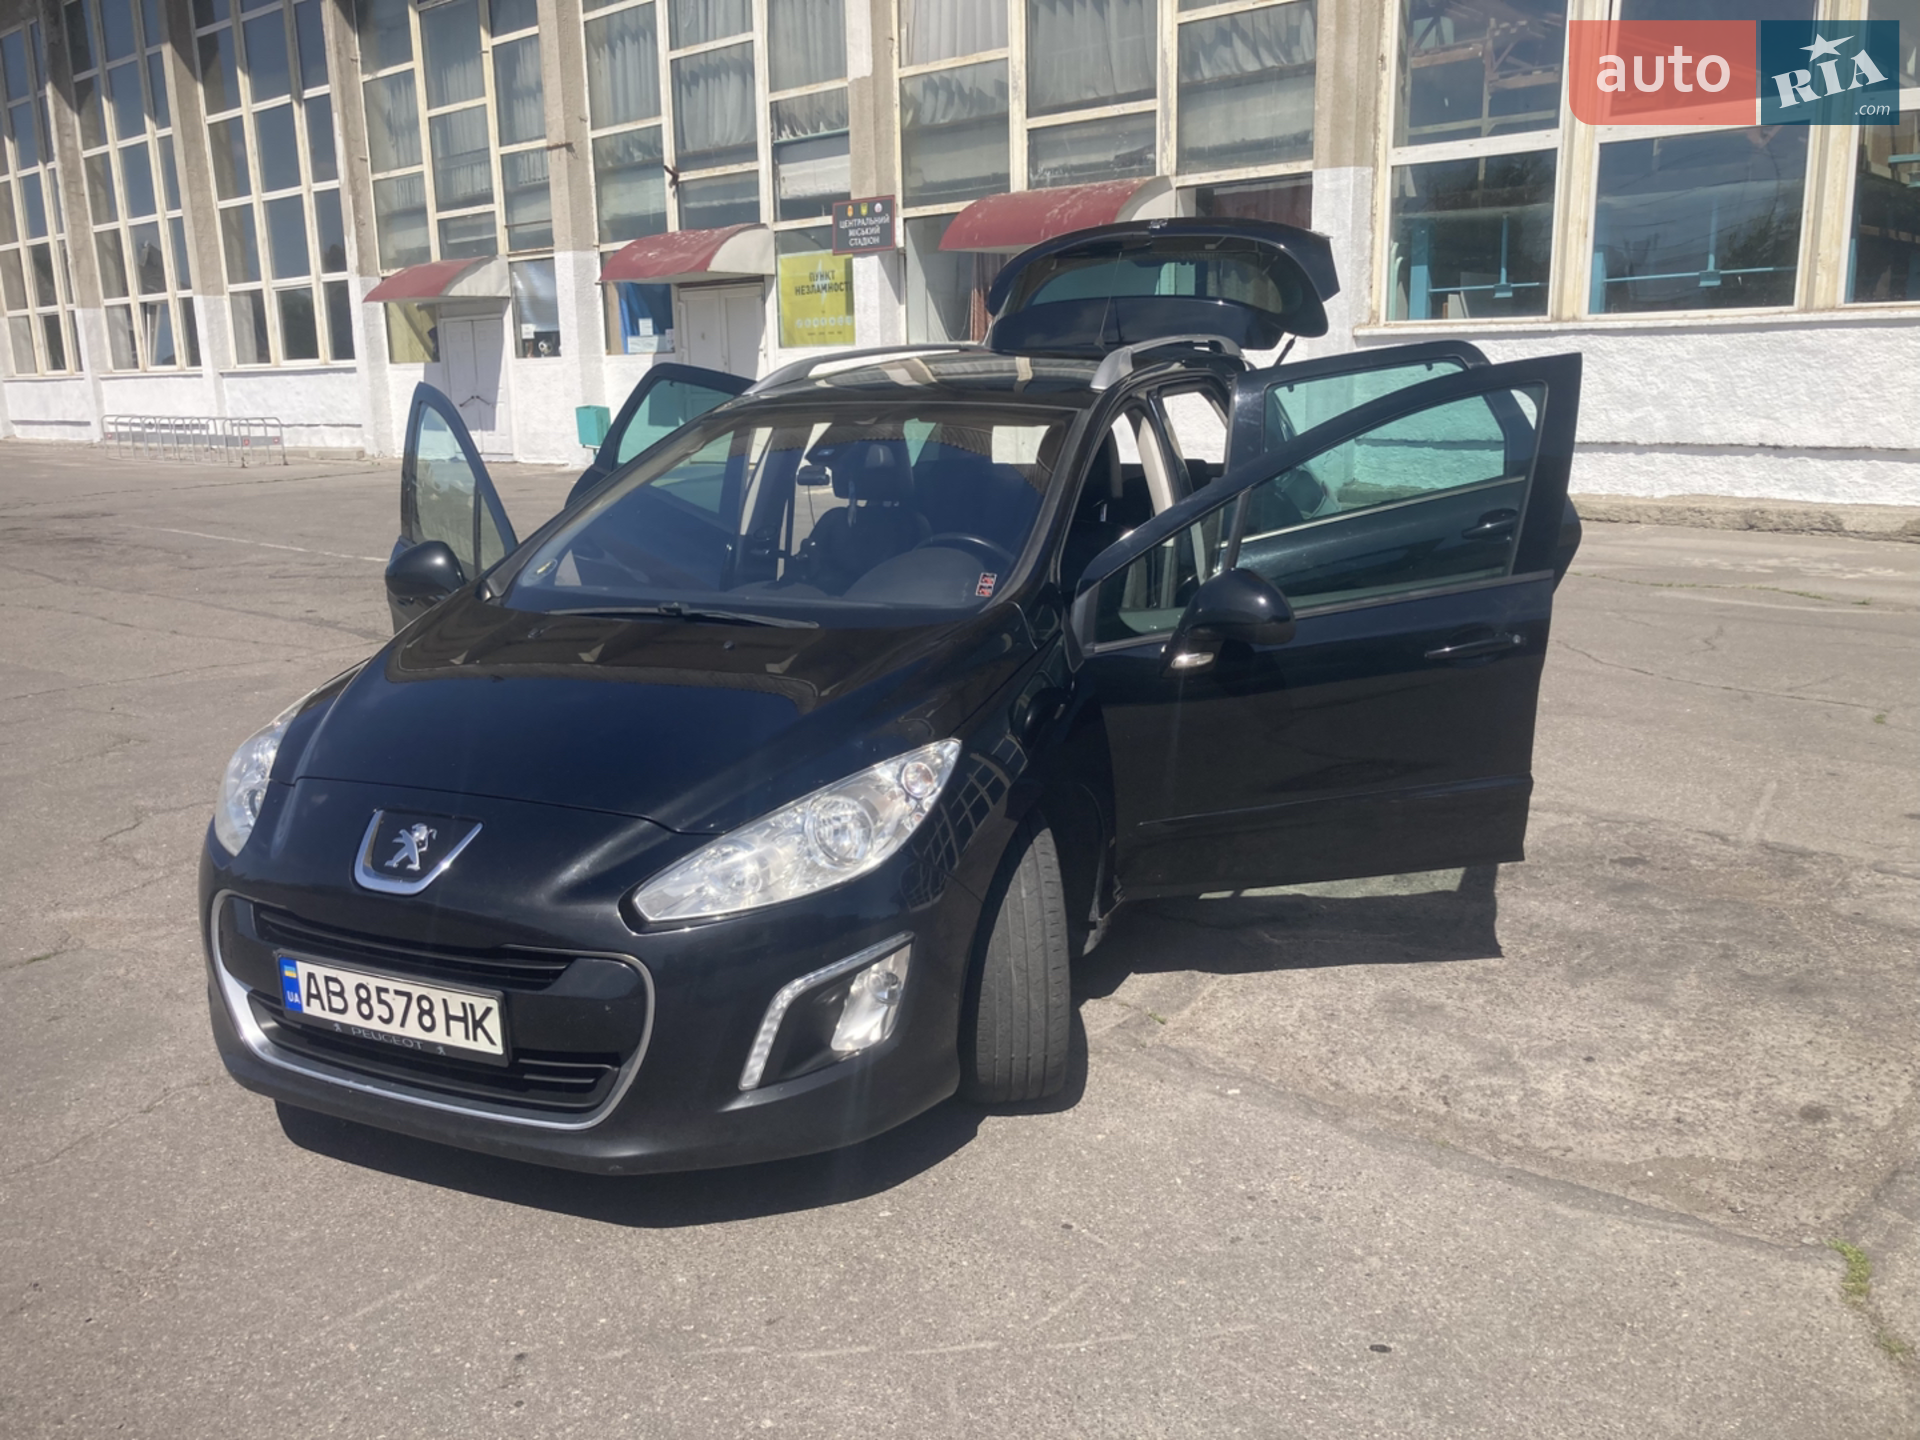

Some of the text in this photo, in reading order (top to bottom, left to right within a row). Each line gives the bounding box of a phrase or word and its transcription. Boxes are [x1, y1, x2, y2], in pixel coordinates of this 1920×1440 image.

[839, 213, 890, 229] ЦЕНТРАЛЬНИЙ
[848, 226, 881, 237] МІСЬКИЙ
[848, 236, 880, 247] СТАДІОН
[809, 270, 835, 282] ПУНКТ
[287, 991, 301, 1005] UA
[306, 971, 498, 1047] AB 8578 HK
[351, 1026, 424, 1050] PEUGEOT
